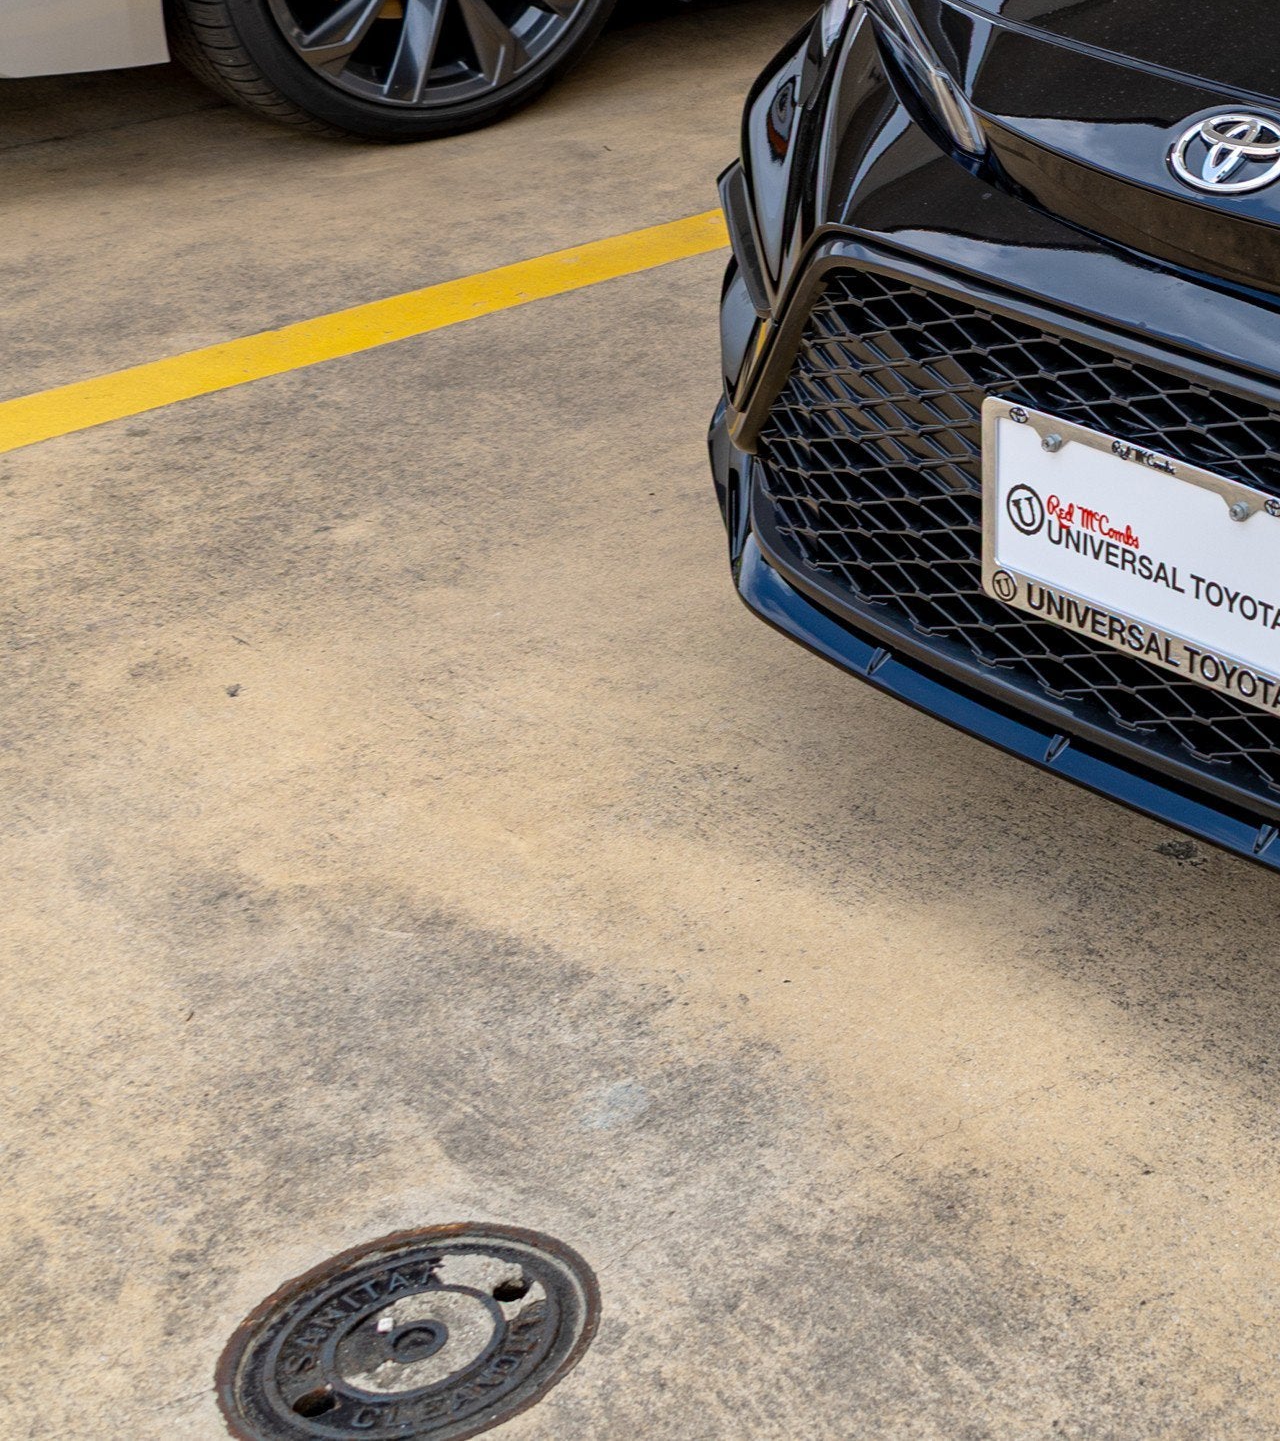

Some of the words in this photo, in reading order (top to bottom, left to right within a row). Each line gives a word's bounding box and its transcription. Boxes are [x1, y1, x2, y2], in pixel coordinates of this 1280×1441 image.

[1046, 494, 1075, 530] Red
[1047, 518, 1185, 594] UNIVERSAL
[1026, 582, 1181, 667] UNIVERSAL
